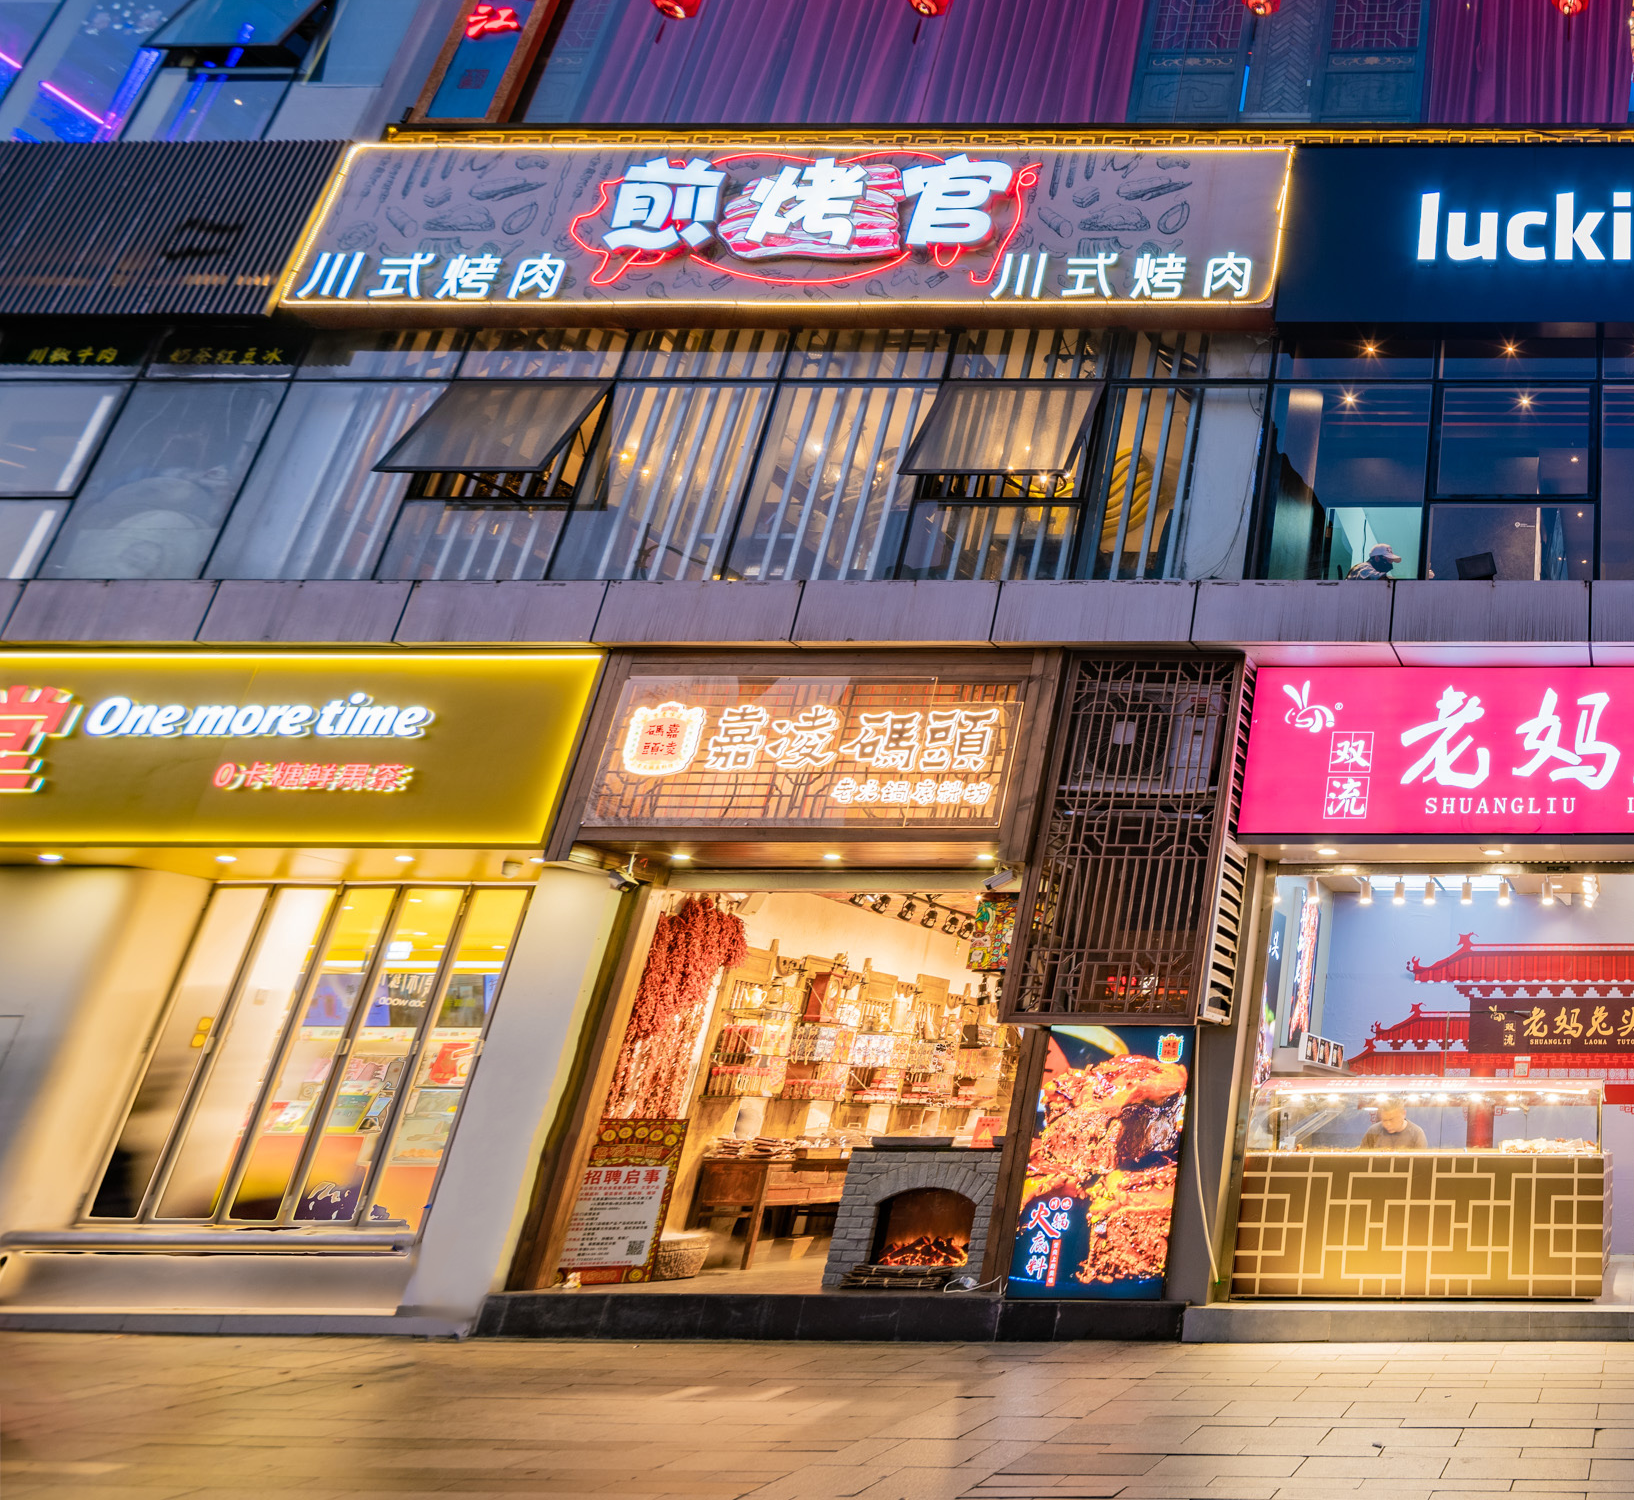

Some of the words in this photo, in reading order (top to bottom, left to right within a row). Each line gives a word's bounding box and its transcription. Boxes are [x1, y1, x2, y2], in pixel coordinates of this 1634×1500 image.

[602, 154, 1012, 252] 煎烤官
[296, 251, 566, 300] 川式烤肉
[991, 252, 1252, 299] 川式烤肉
[87, 695, 189, 737] One
[186, 703, 317, 737] more
[315, 692, 434, 738] time
[1326, 734, 1372, 818] 双流
[1425, 796, 1576, 815] SHUANGLIU
[1503, 1022, 1516, 1046] 双流
[1529, 1038, 1571, 1046] SHUANGLIU
[1584, 1038, 1607, 1046] LAOMA
[584, 1169, 662, 1185] 招聘启事
